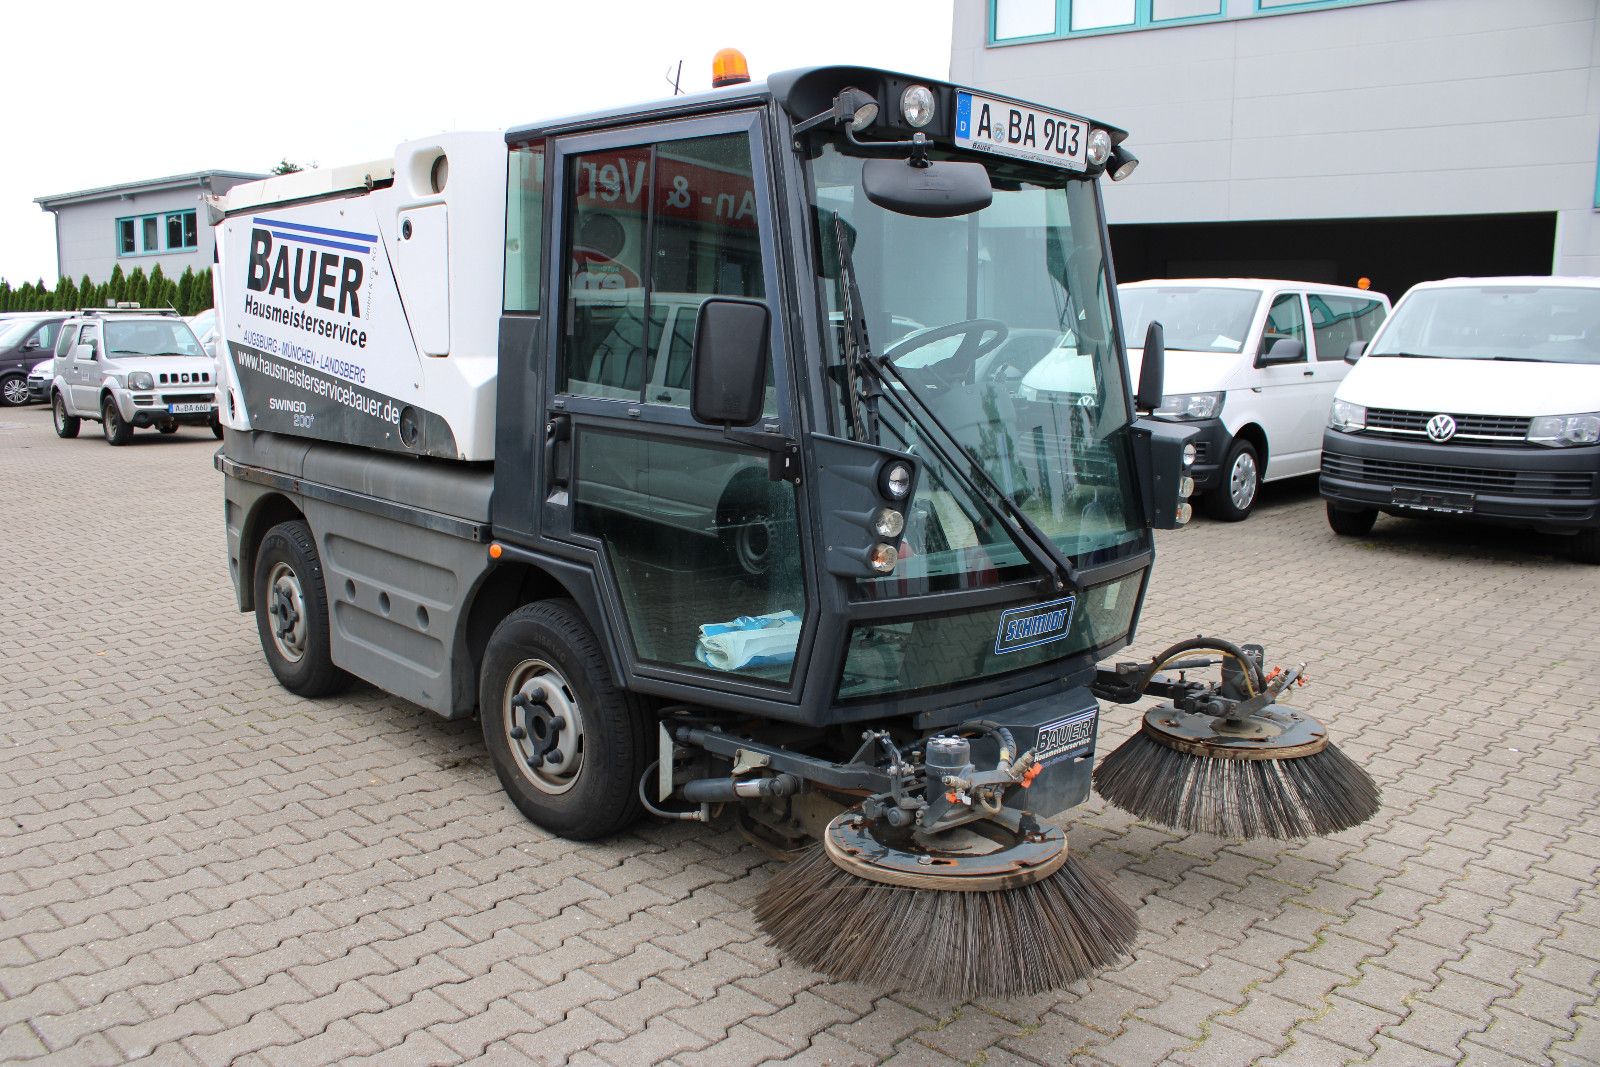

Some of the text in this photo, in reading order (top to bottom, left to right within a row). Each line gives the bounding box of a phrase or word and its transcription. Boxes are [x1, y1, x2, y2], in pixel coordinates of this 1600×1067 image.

[977, 103, 1080, 157] A BA 903
[247, 228, 364, 319] BAUER
[244, 294, 367, 349] Hausmeisterservice
[243, 329, 277, 353] AUGSBURG
[282, 341, 316, 365] MÜNCHEN
[320, 351, 366, 384] LANDSBERG
[237, 350, 400, 425] www.hausmeisterservicebauer.de
[269, 397, 307, 414] SWINGO
[1005, 608, 1067, 641] SCHMIDT
[1036, 719, 1090, 753] BAUER
